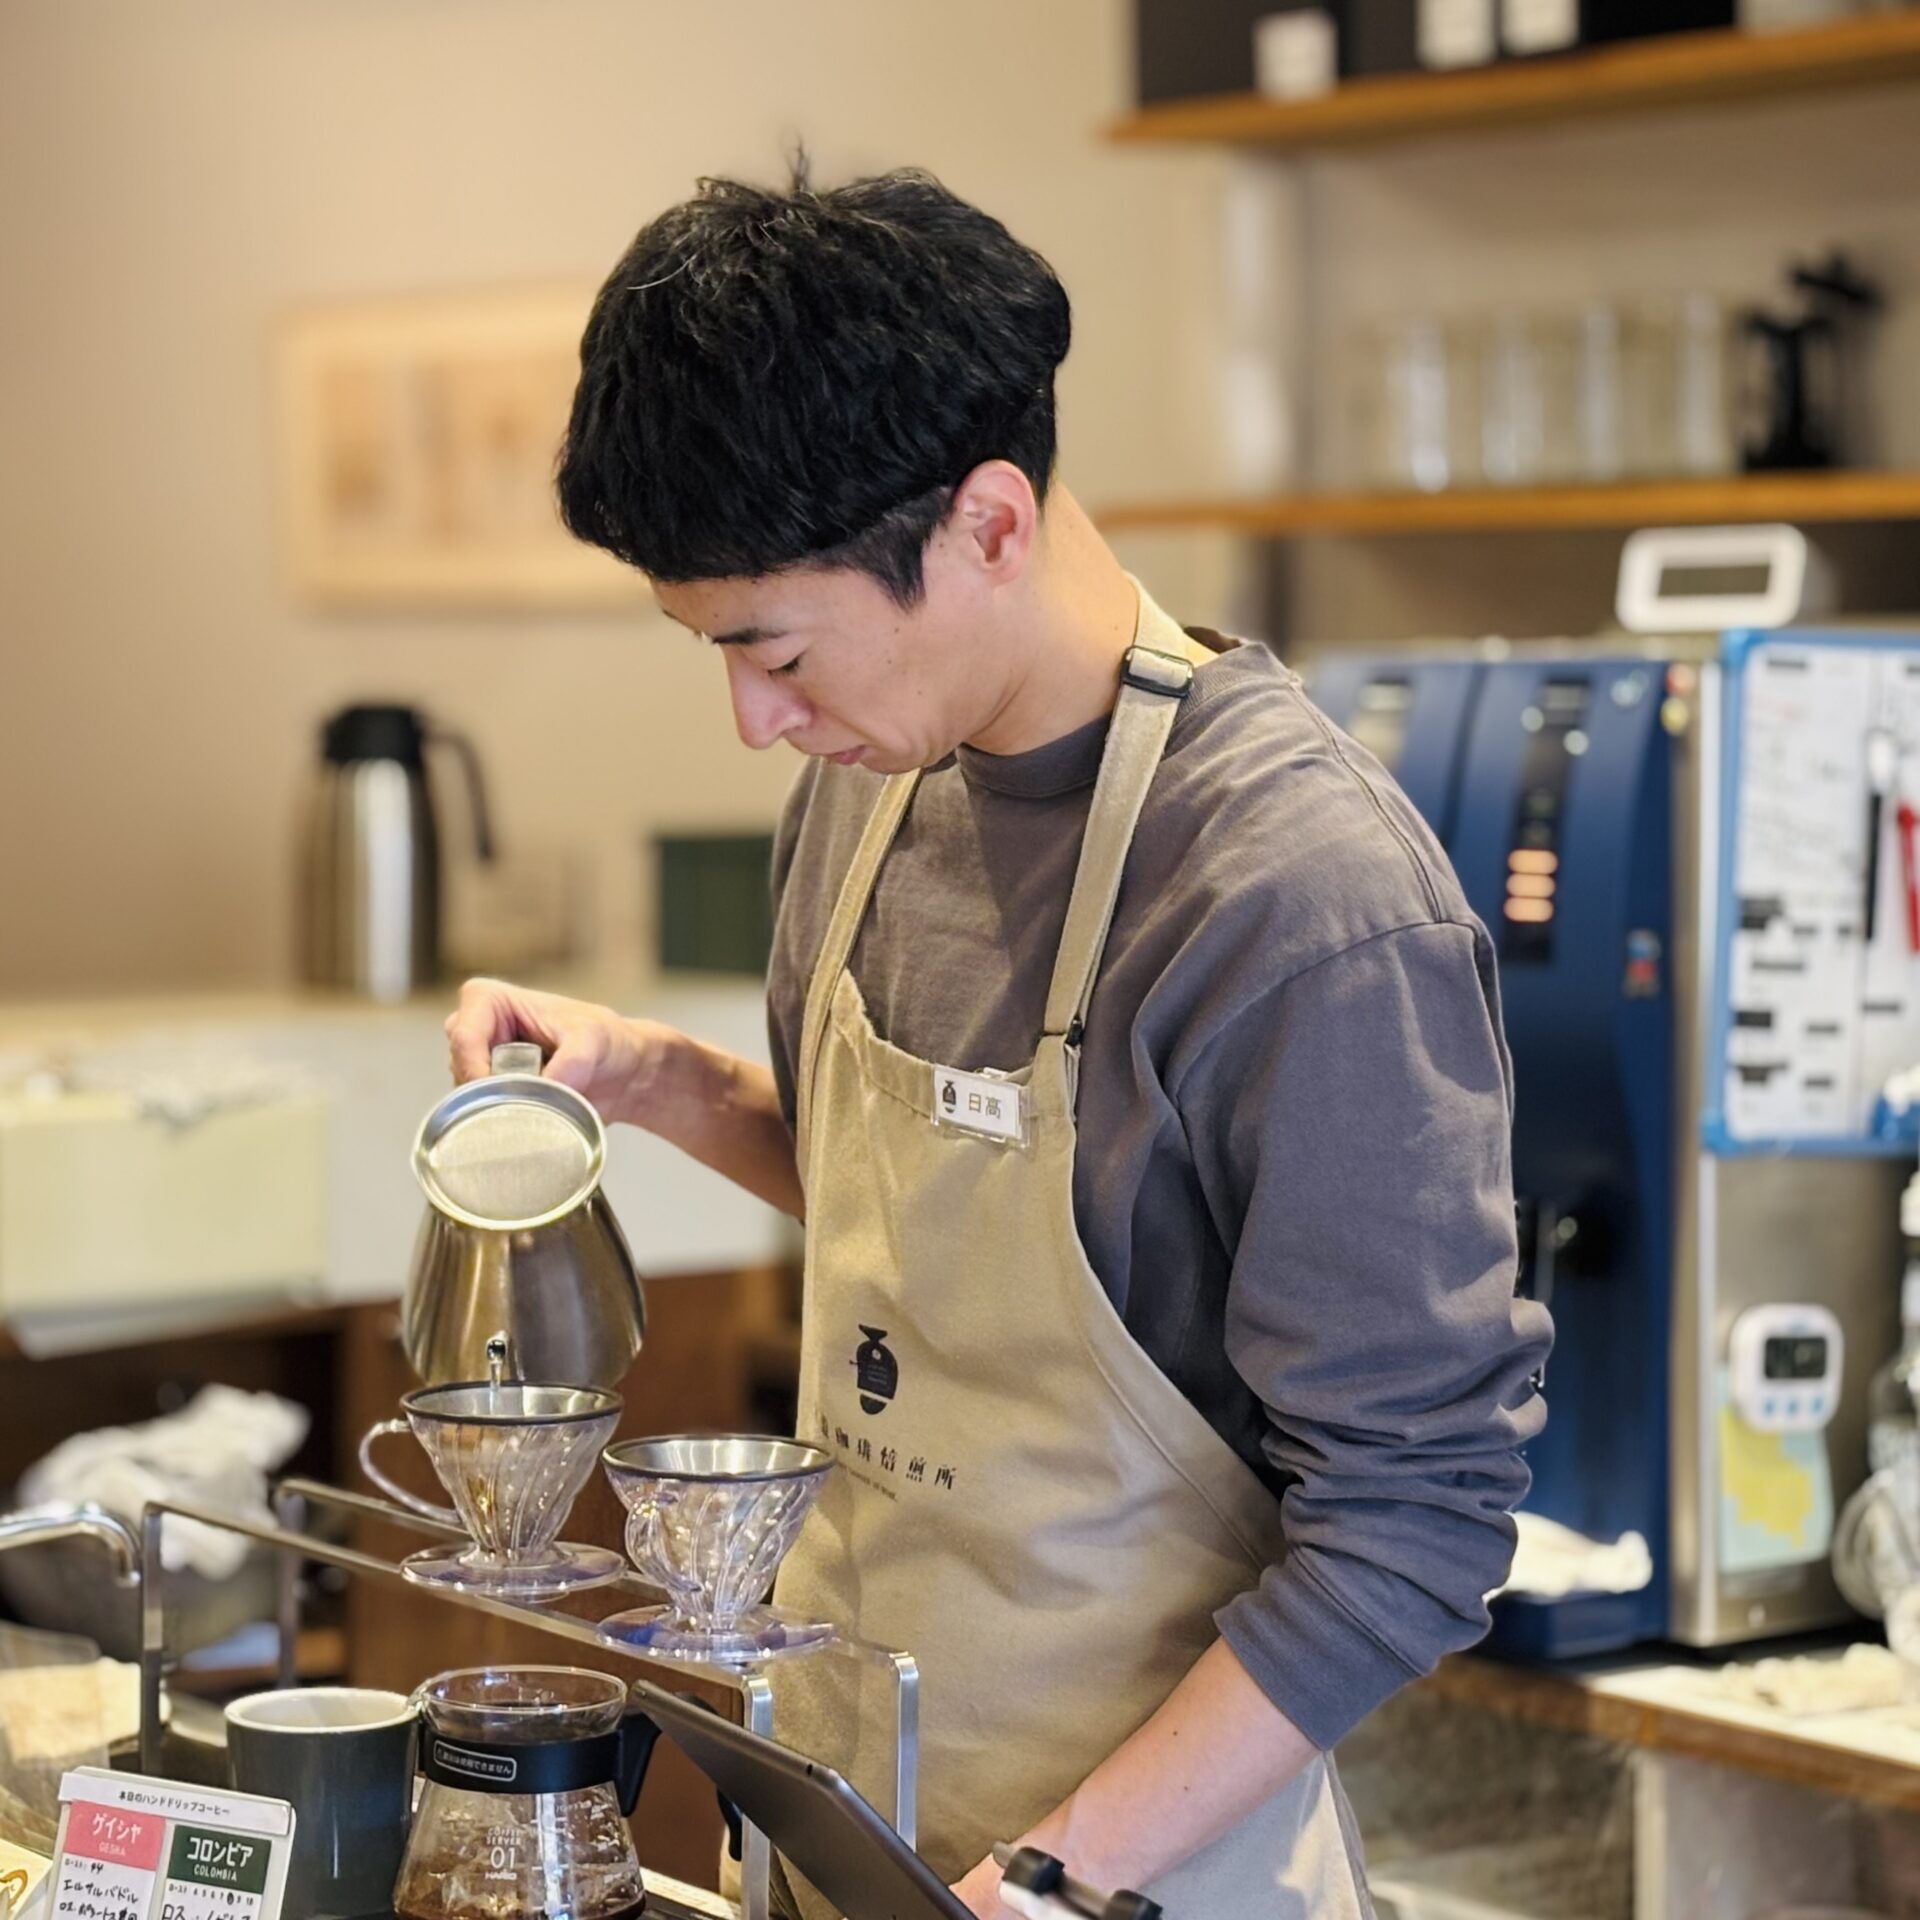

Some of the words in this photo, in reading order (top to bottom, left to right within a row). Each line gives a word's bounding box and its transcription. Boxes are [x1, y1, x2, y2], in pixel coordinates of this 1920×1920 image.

[119, 1791, 230, 1815] 本日のハンドドリップコーヒー
[187, 1837, 254, 1868] コロンビア
[491, 1846, 515, 1869] 01
[194, 1864, 237, 1882] COLOMBIA
